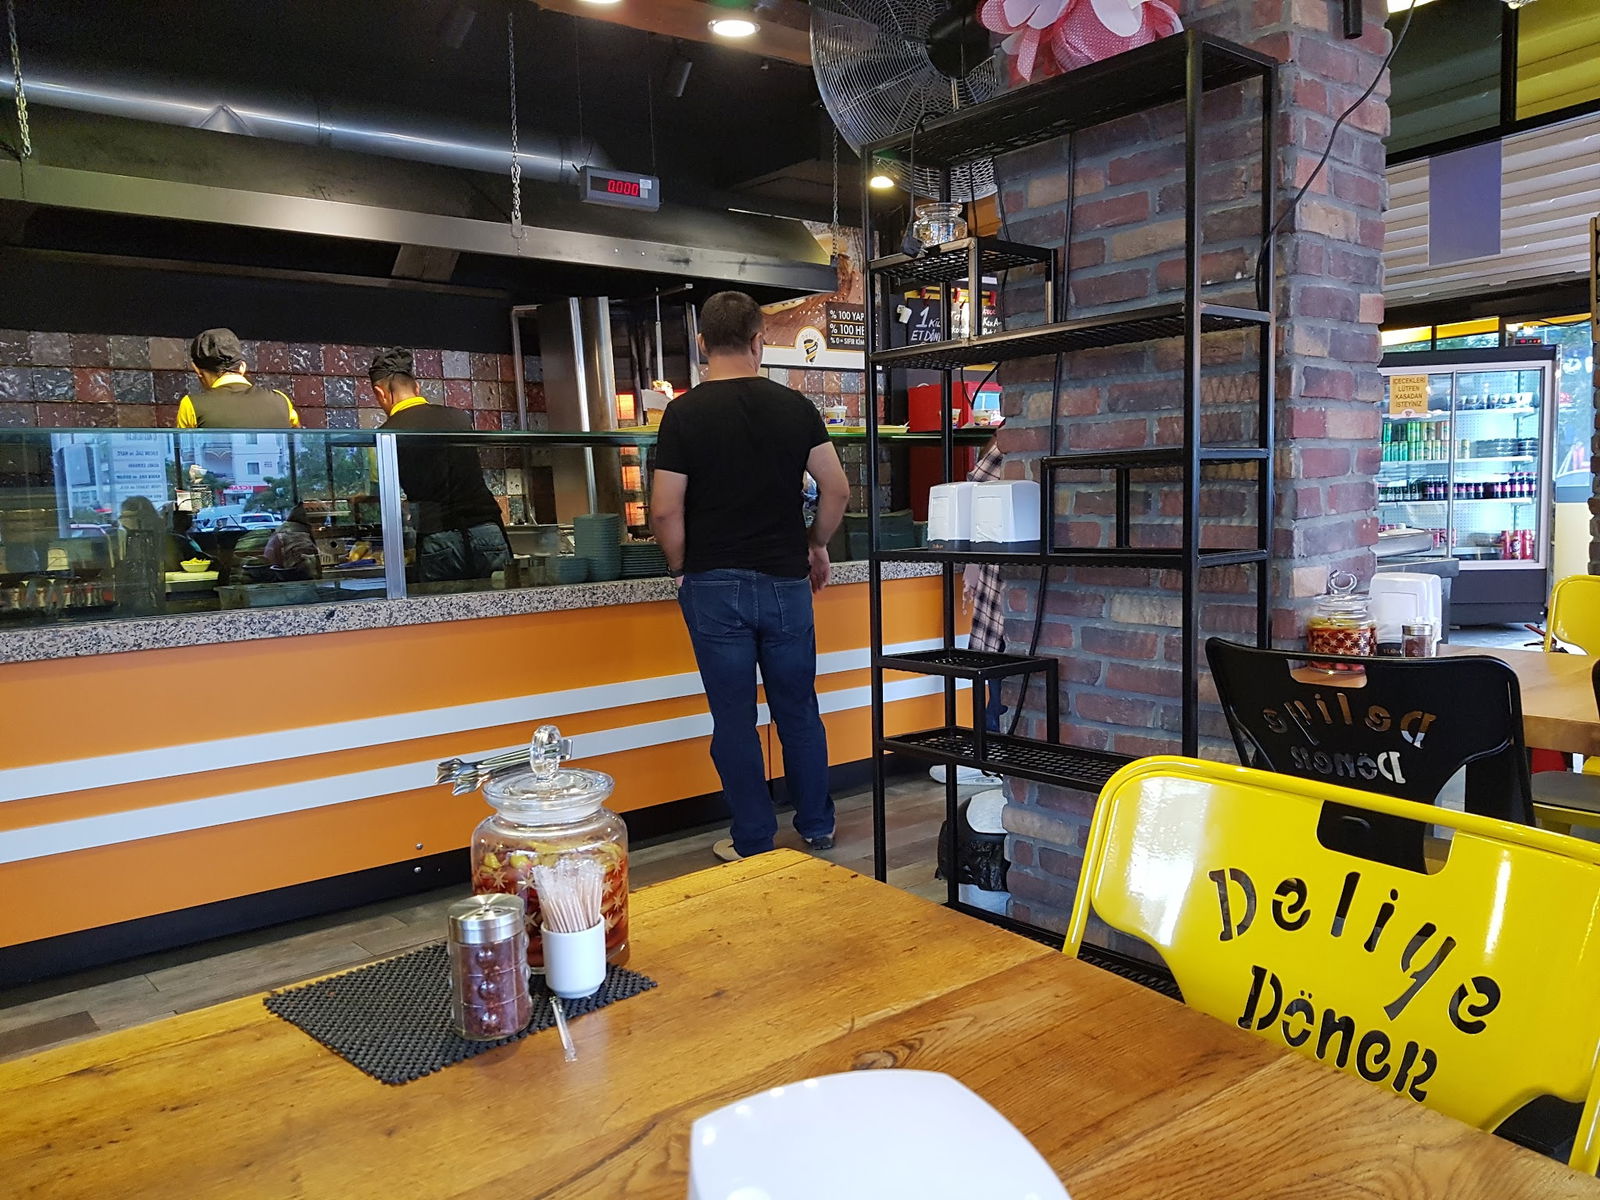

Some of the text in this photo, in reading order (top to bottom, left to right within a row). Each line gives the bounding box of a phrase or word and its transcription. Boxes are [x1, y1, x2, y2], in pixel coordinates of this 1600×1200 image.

[608, 180, 639, 196] 0.000
[839, 311, 851, 320] 100
[840, 325, 854, 335] 100
[1208, 867, 1501, 1035] Deliye
